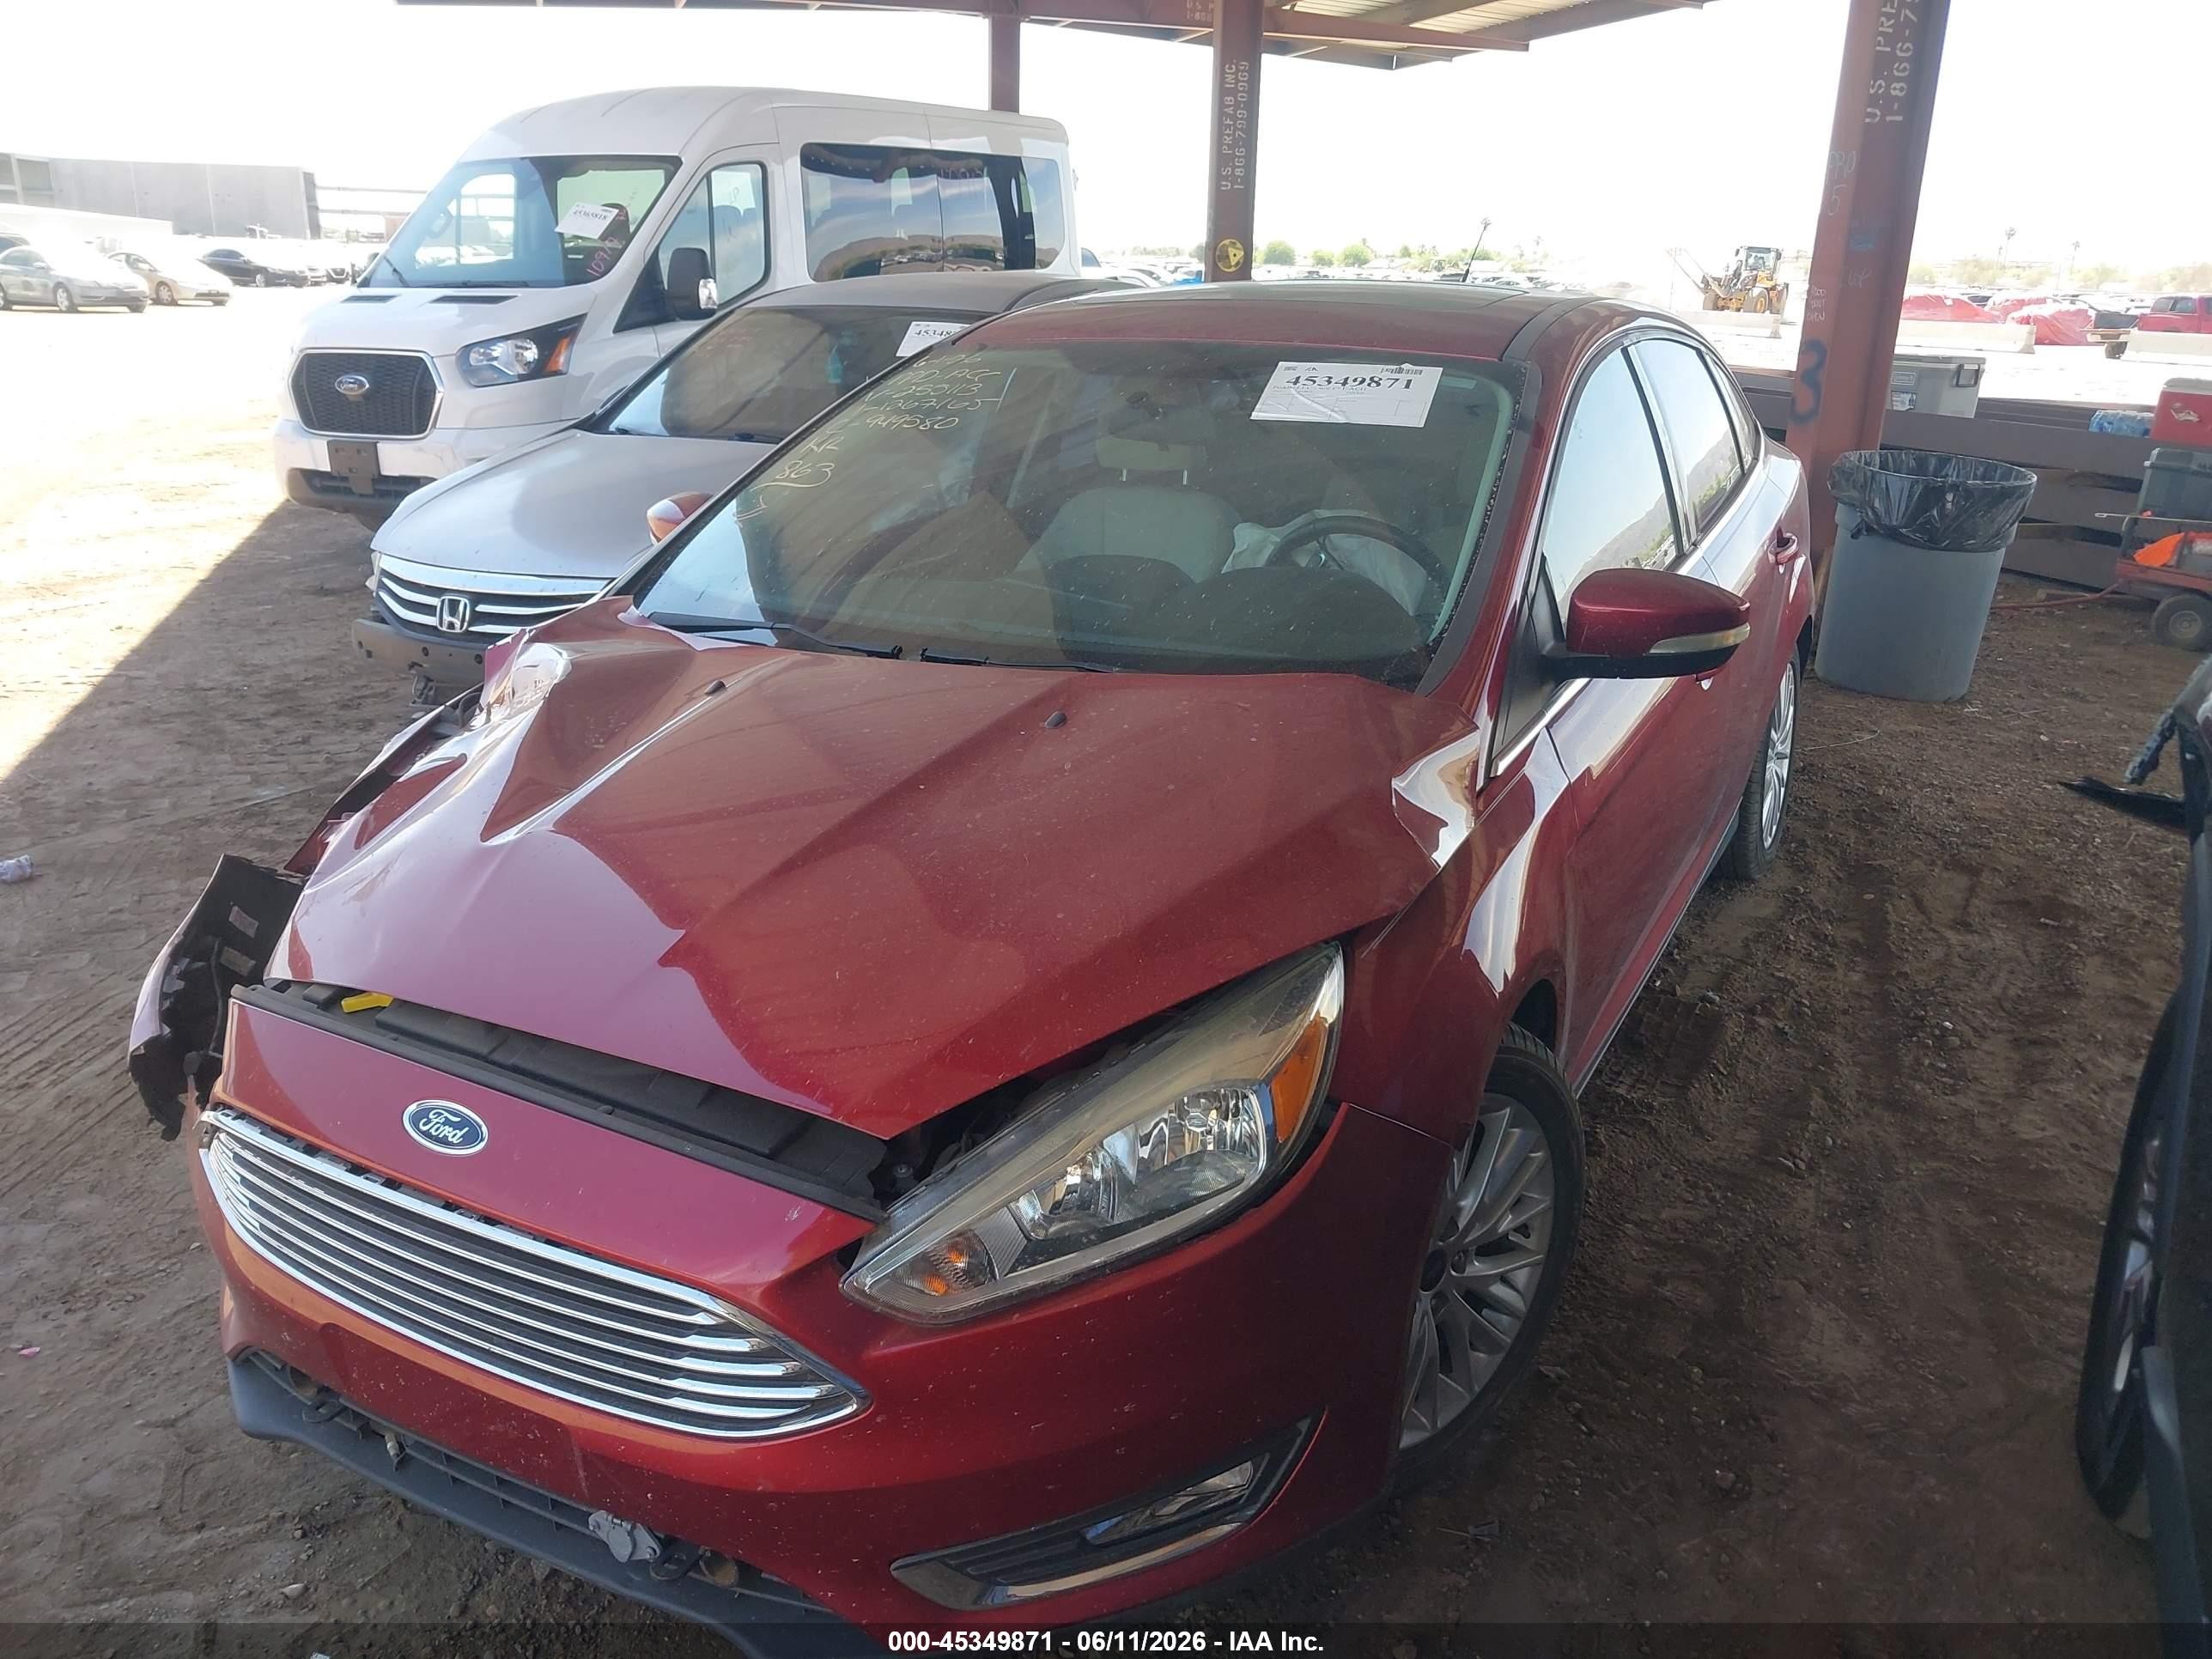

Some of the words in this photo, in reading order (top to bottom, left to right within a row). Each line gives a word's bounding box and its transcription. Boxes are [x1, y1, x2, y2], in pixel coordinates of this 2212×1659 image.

[1224, 59, 1237, 88] INC.
[1885, 0, 1920, 121] 1-866-7
[1864, 71, 1887, 123] U.S.
[1222, 96, 1235, 154] PREFAB
[1234, 61, 1250, 189] 1-866-799-0969
[1221, 162, 1233, 191] U.S.
[914, 329, 957, 337] 45348
[1285, 374, 1414, 390] 45349871
[1789, 338, 1827, 427] 3
[418, 1109, 470, 1144] Ford
